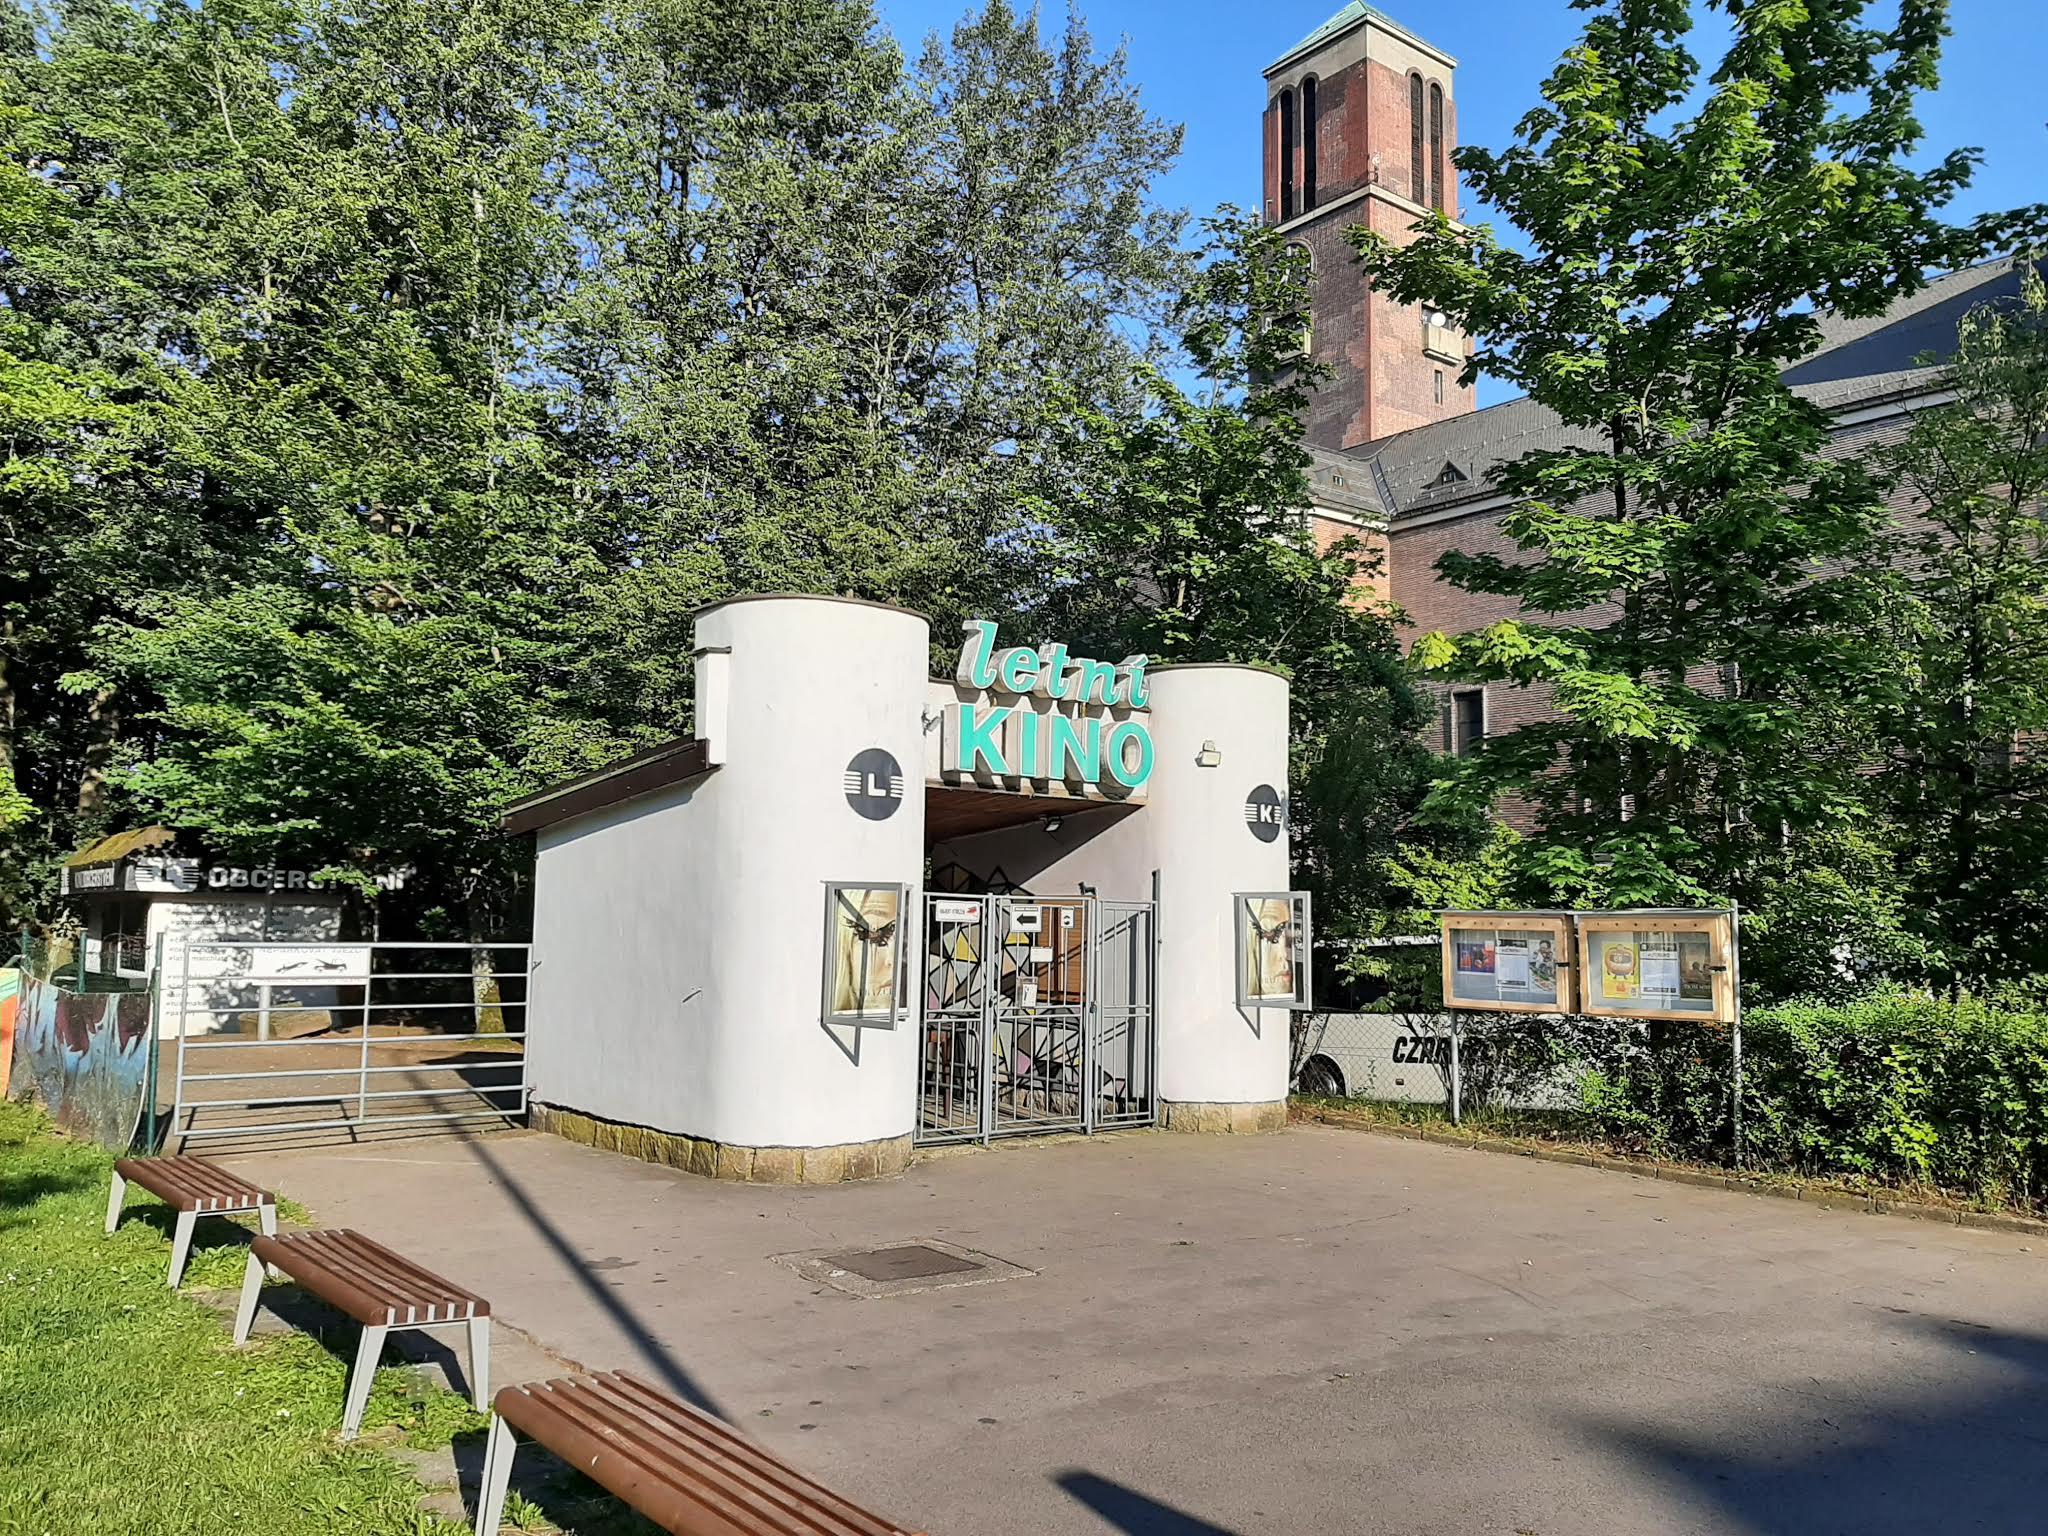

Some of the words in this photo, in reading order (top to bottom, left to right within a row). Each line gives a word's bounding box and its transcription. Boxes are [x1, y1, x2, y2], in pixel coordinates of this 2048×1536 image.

[957, 620, 1150, 709] letní
[956, 702, 1155, 788] KINO
[867, 773, 886, 797] L
[1259, 802, 1275, 824] K
[208, 864, 405, 890] OBČERSNÍ
